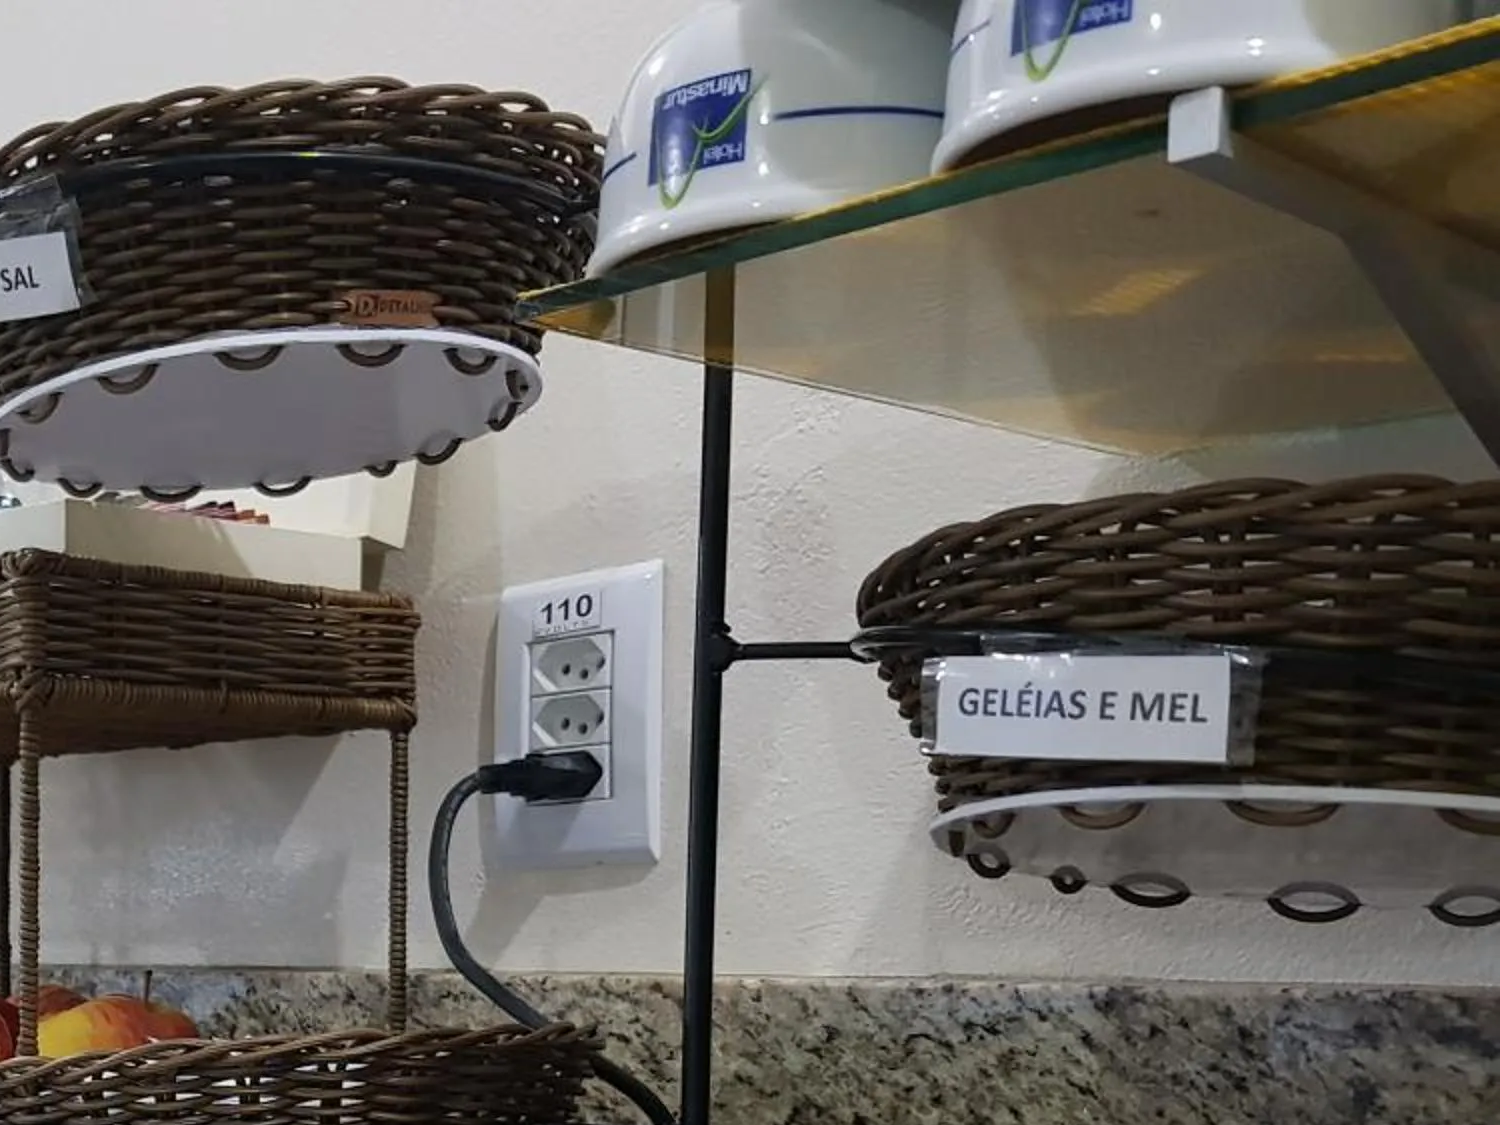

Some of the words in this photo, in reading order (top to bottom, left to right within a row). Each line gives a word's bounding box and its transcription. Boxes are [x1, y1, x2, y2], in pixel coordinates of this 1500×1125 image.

[662, 72, 749, 110] Minastur
[703, 142, 743, 165] Hotel
[0, 265, 41, 292] SAL
[540, 594, 593, 625] 110
[958, 681, 1087, 720] GELÉIAS
[1099, 690, 1119, 721] E
[1129, 691, 1209, 723] MEL
